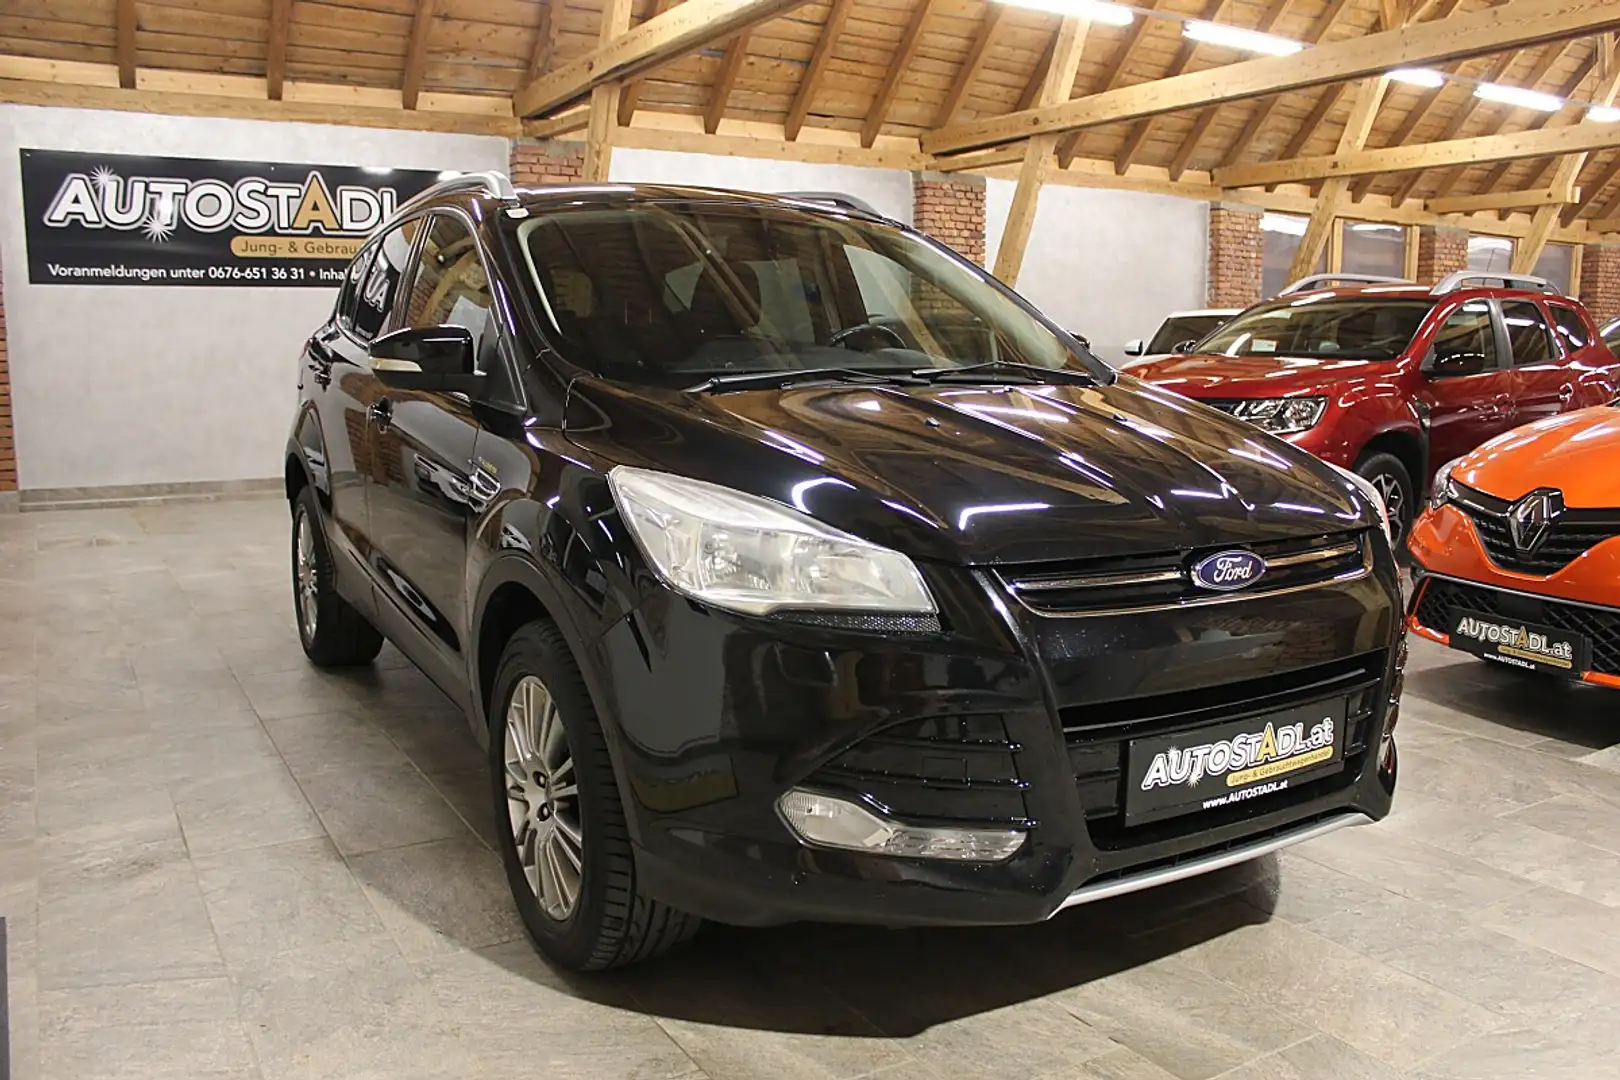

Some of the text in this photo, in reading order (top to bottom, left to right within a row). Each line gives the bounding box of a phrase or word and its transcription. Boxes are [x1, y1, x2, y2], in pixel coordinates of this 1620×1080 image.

[240, 240, 283, 256] Jung-
[287, 241, 300, 254] &
[47, 264, 167, 281] Voranmeldungen
[170, 267, 206, 279] unter
[208, 266, 267, 280] 0676-651
[271, 267, 288, 280] 36
[290, 267, 305, 280] 31
[1213, 557, 1253, 583] Ford
[1456, 617, 1573, 660] AUTOSTADL.at
[1141, 717, 1334, 790] AUTOSTADL.at
[1202, 779, 1289, 809] www.AUTOSTADL.at
